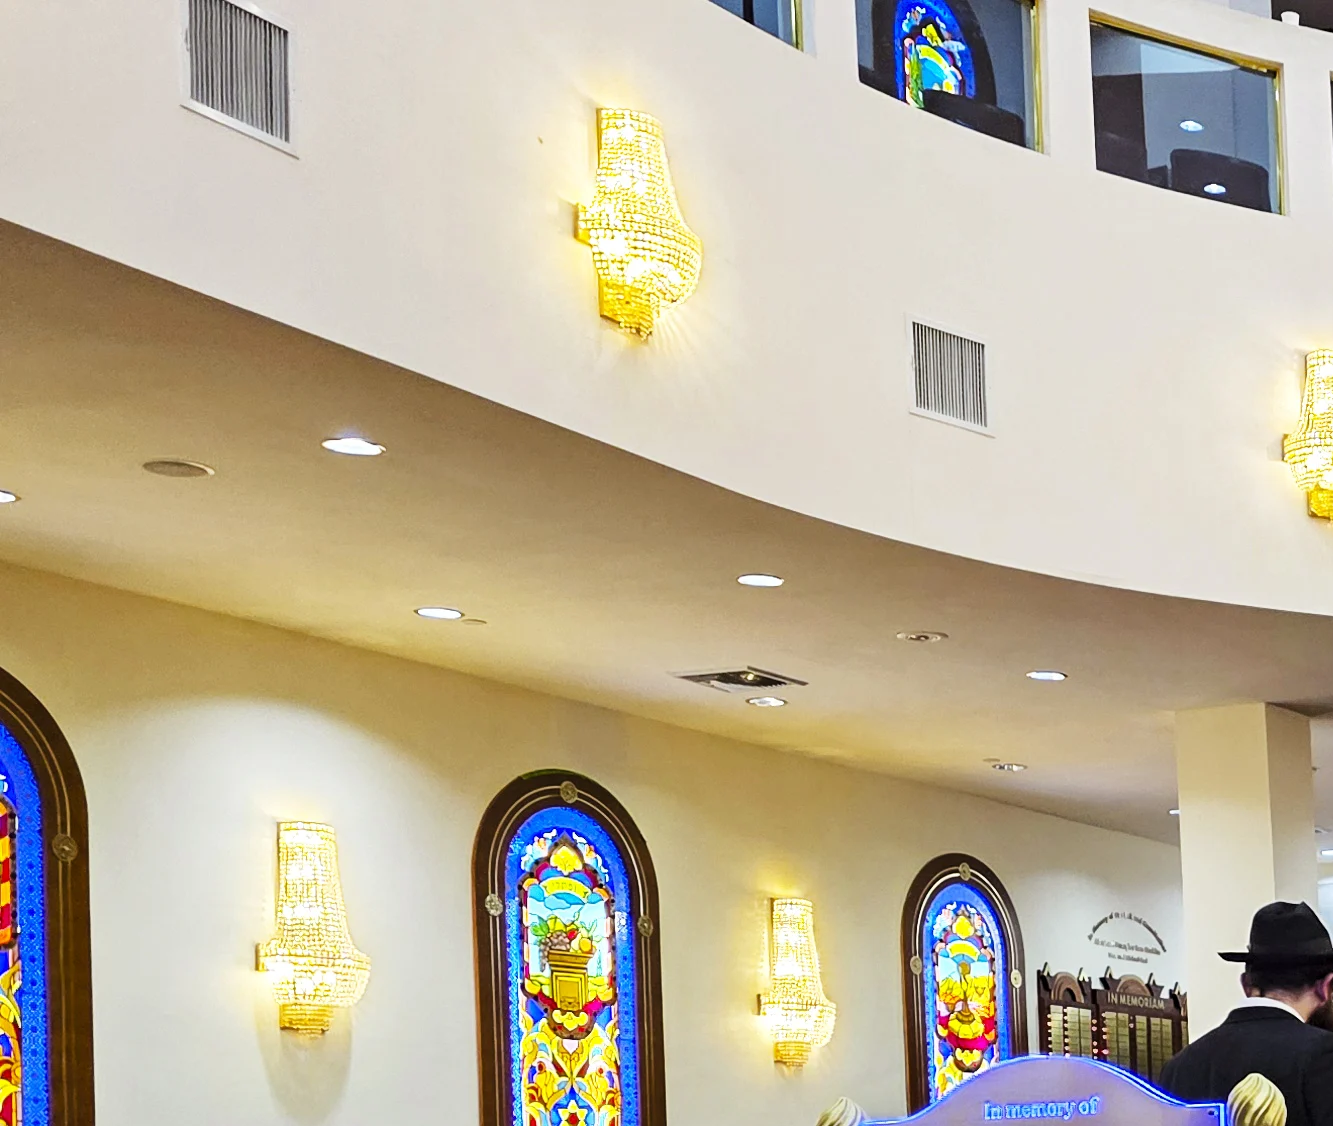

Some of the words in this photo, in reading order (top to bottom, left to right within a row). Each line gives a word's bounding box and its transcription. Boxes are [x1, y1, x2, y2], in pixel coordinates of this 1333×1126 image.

[1107, 991, 1118, 1005] IN
[1119, 993, 1165, 1010] MEMORIAM
[984, 1101, 1003, 1121] In
[1005, 1101, 1077, 1121] memory
[1079, 1096, 1100, 1116] of
